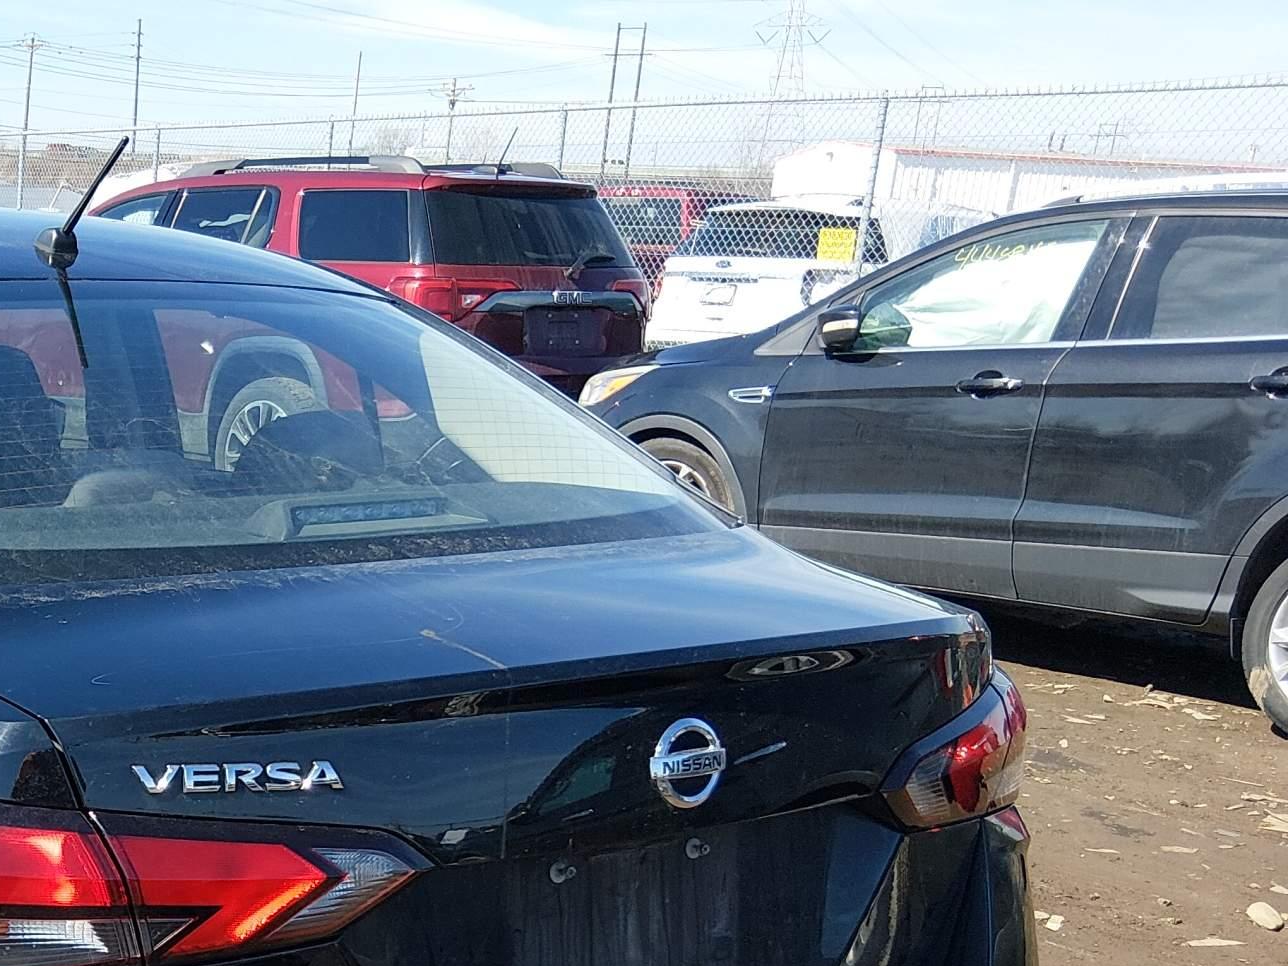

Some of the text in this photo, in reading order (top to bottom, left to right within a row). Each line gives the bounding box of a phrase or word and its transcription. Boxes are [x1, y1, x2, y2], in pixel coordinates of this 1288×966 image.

[552, 290, 593, 305] GMC
[662, 754, 722, 775] NISSAN
[131, 760, 345, 794] VERSA
